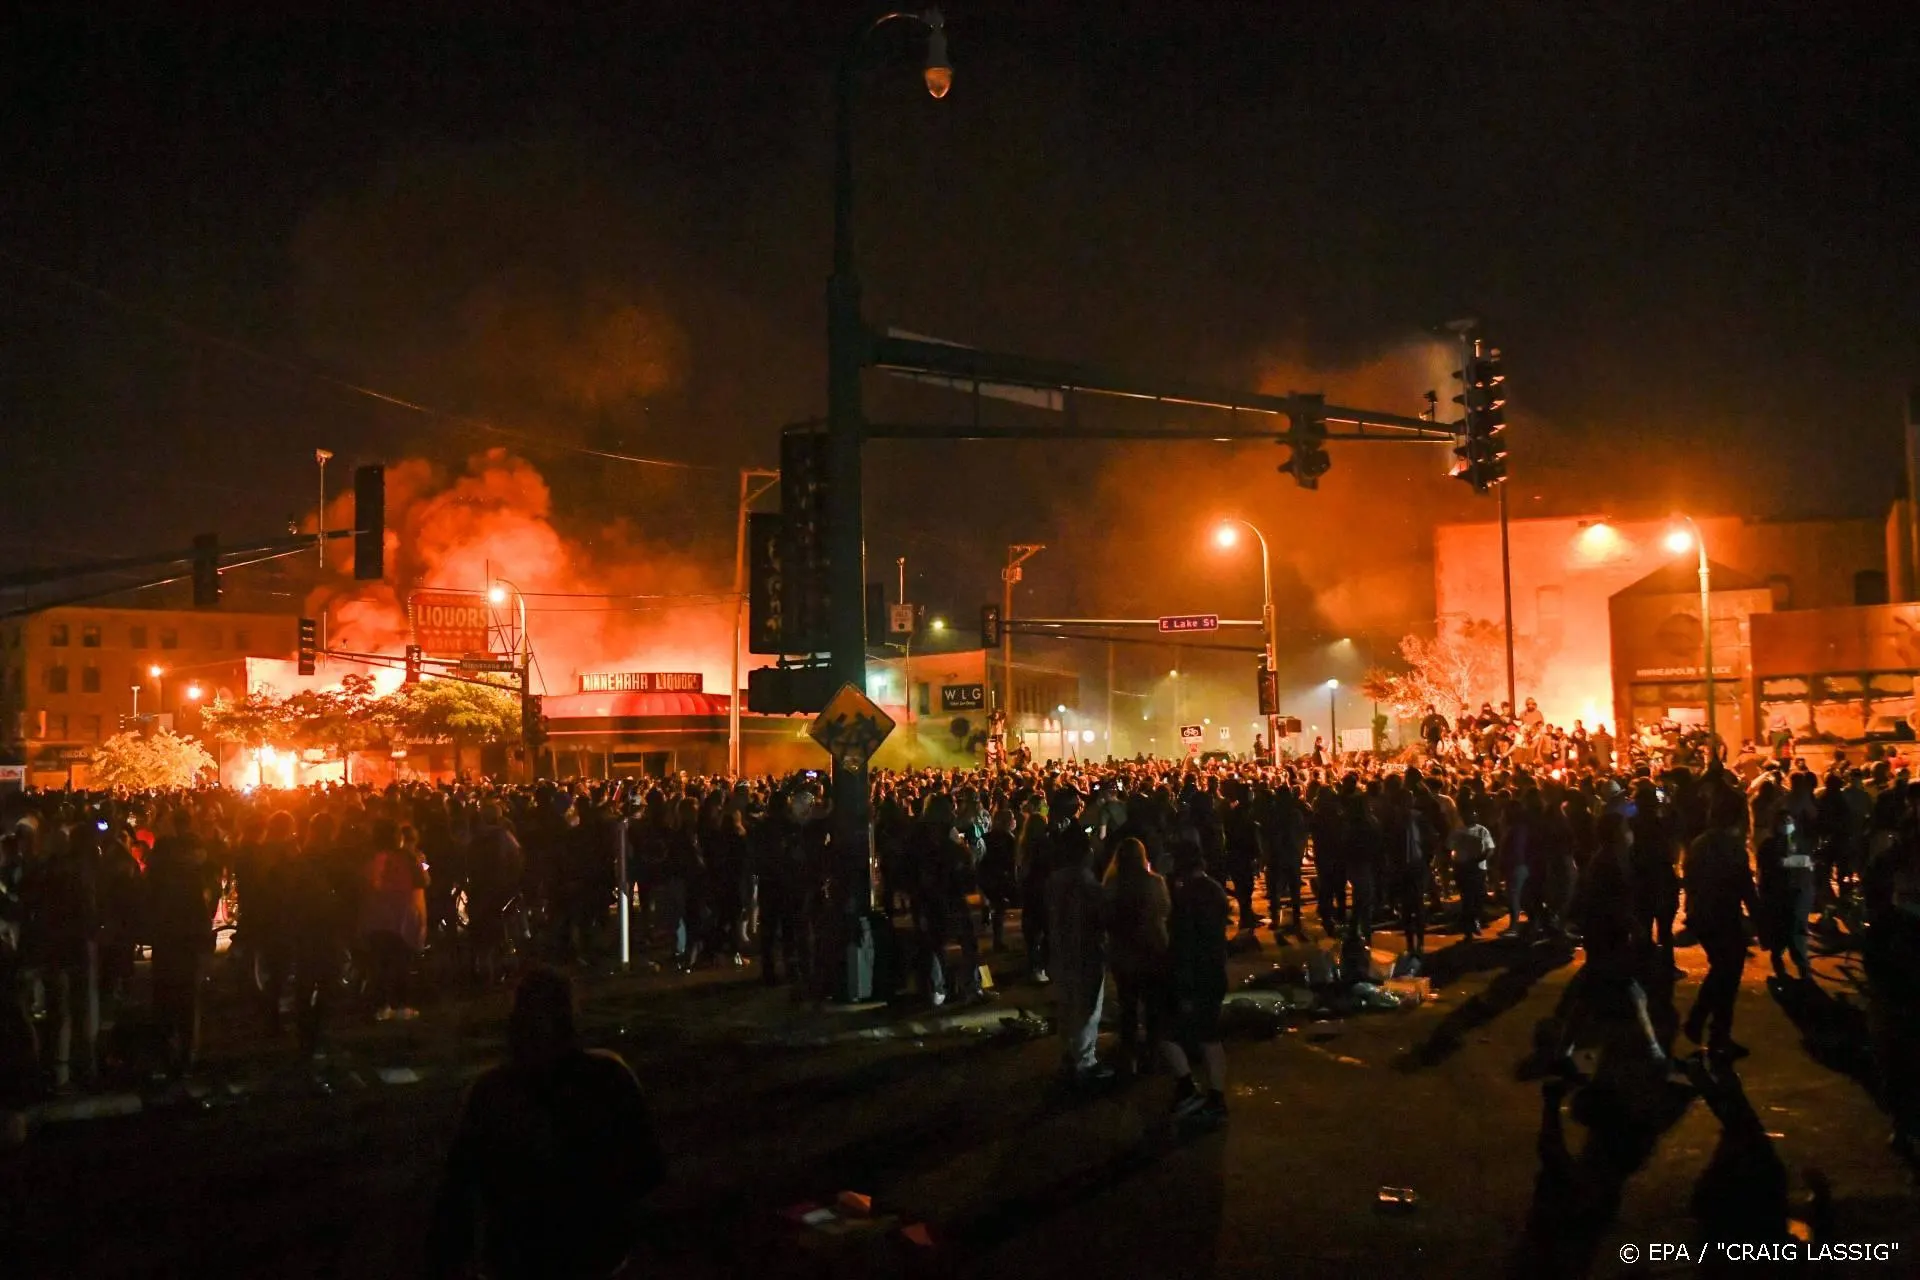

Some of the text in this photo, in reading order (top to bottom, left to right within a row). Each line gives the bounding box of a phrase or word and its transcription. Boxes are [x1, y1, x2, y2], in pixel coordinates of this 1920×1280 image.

[417, 605, 488, 628] LIQUORS
[1162, 618, 1215, 629] E Lake St
[583, 673, 700, 691] MINNEHAHA LIQUORS
